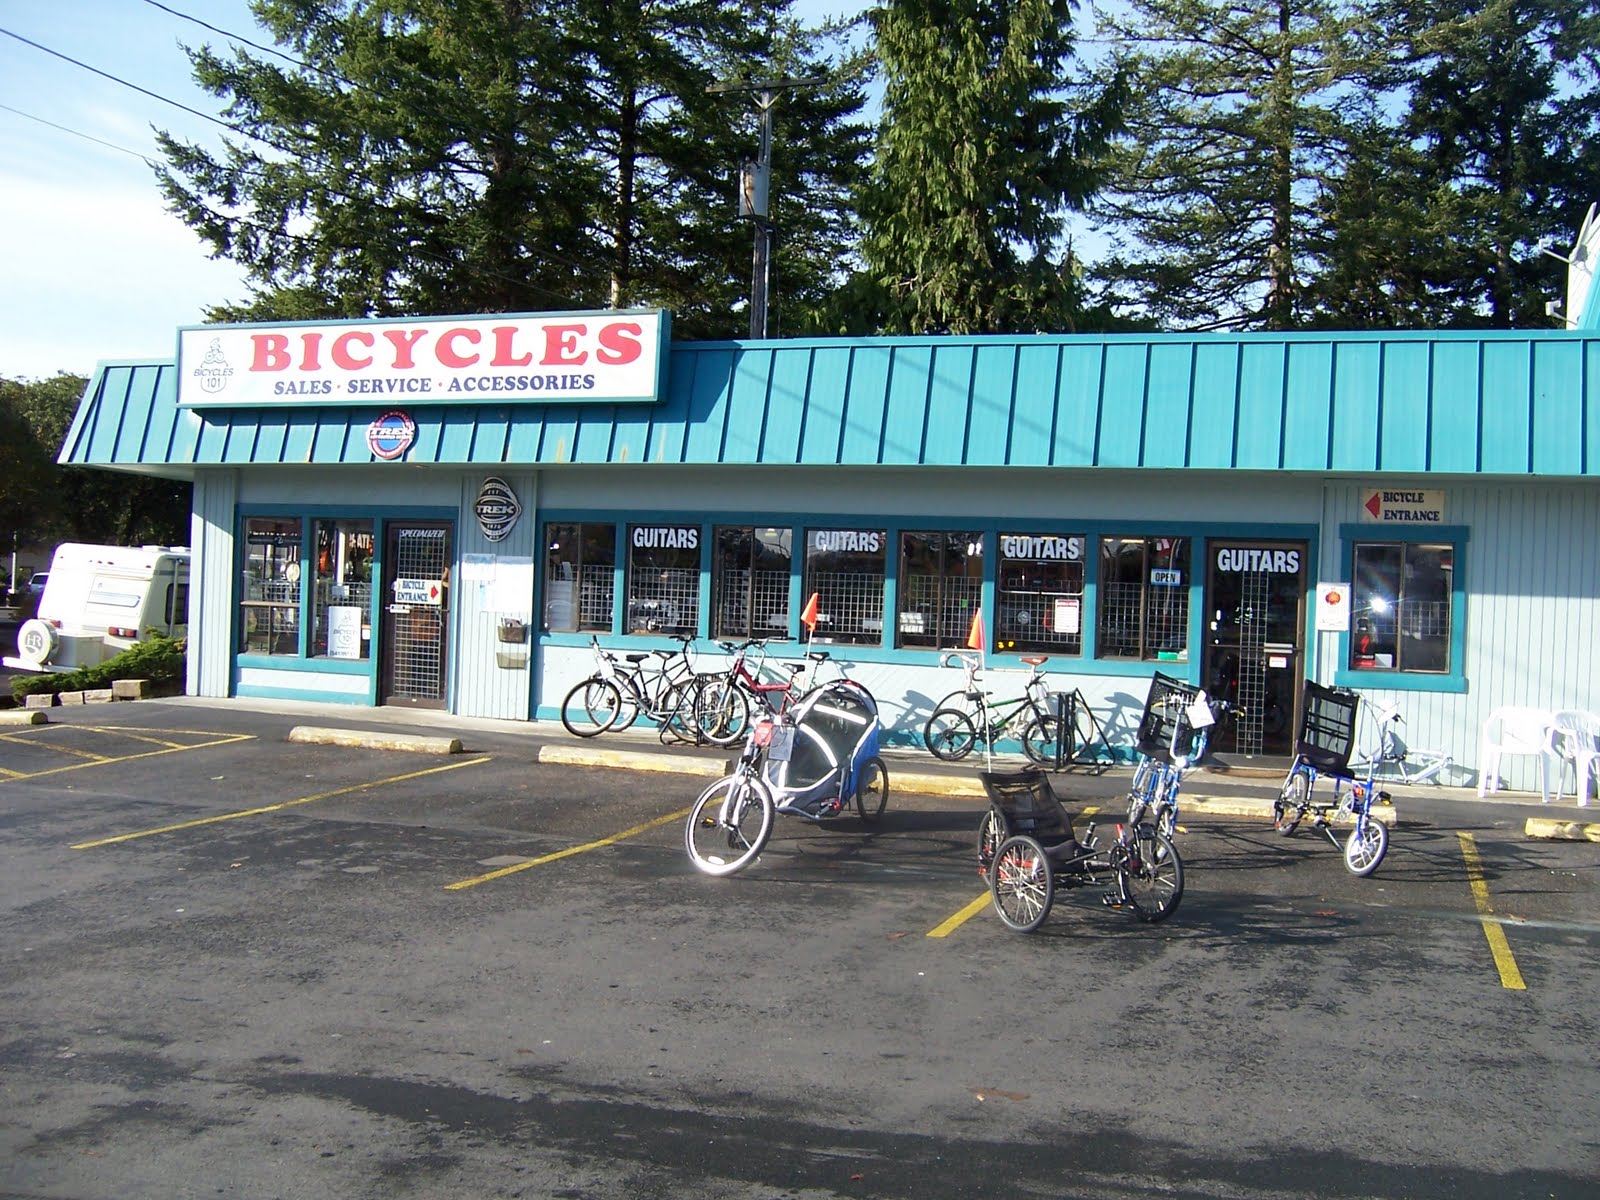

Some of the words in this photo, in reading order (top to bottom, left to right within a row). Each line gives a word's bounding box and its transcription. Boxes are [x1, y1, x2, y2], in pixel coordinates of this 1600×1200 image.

[249, 322, 642, 371] BICYCLES
[193, 367, 234, 377] BICYCLES
[207, 377, 220, 388] 101
[273, 380, 333, 396] SALES
[346, 376, 432, 394] SERVICE
[447, 374, 596, 393] ACCESSORIES
[1383, 492, 1425, 503] BICYCLE
[476, 505, 515, 514] TREK
[1384, 510, 1440, 521] ENTRANCE
[400, 528, 446, 538] SPECIALIZED
[633, 526, 698, 549] GUITARS
[815, 530, 879, 552] GUITARS
[1003, 537, 1080, 560] GUITARS
[1217, 549, 1300, 574] GUITARS
[1154, 572, 1176, 583] OPEN
[402, 580, 426, 590] BICYCLE
[397, 591, 428, 602] ENTRANCE
[26, 635, 43, 647] HR
